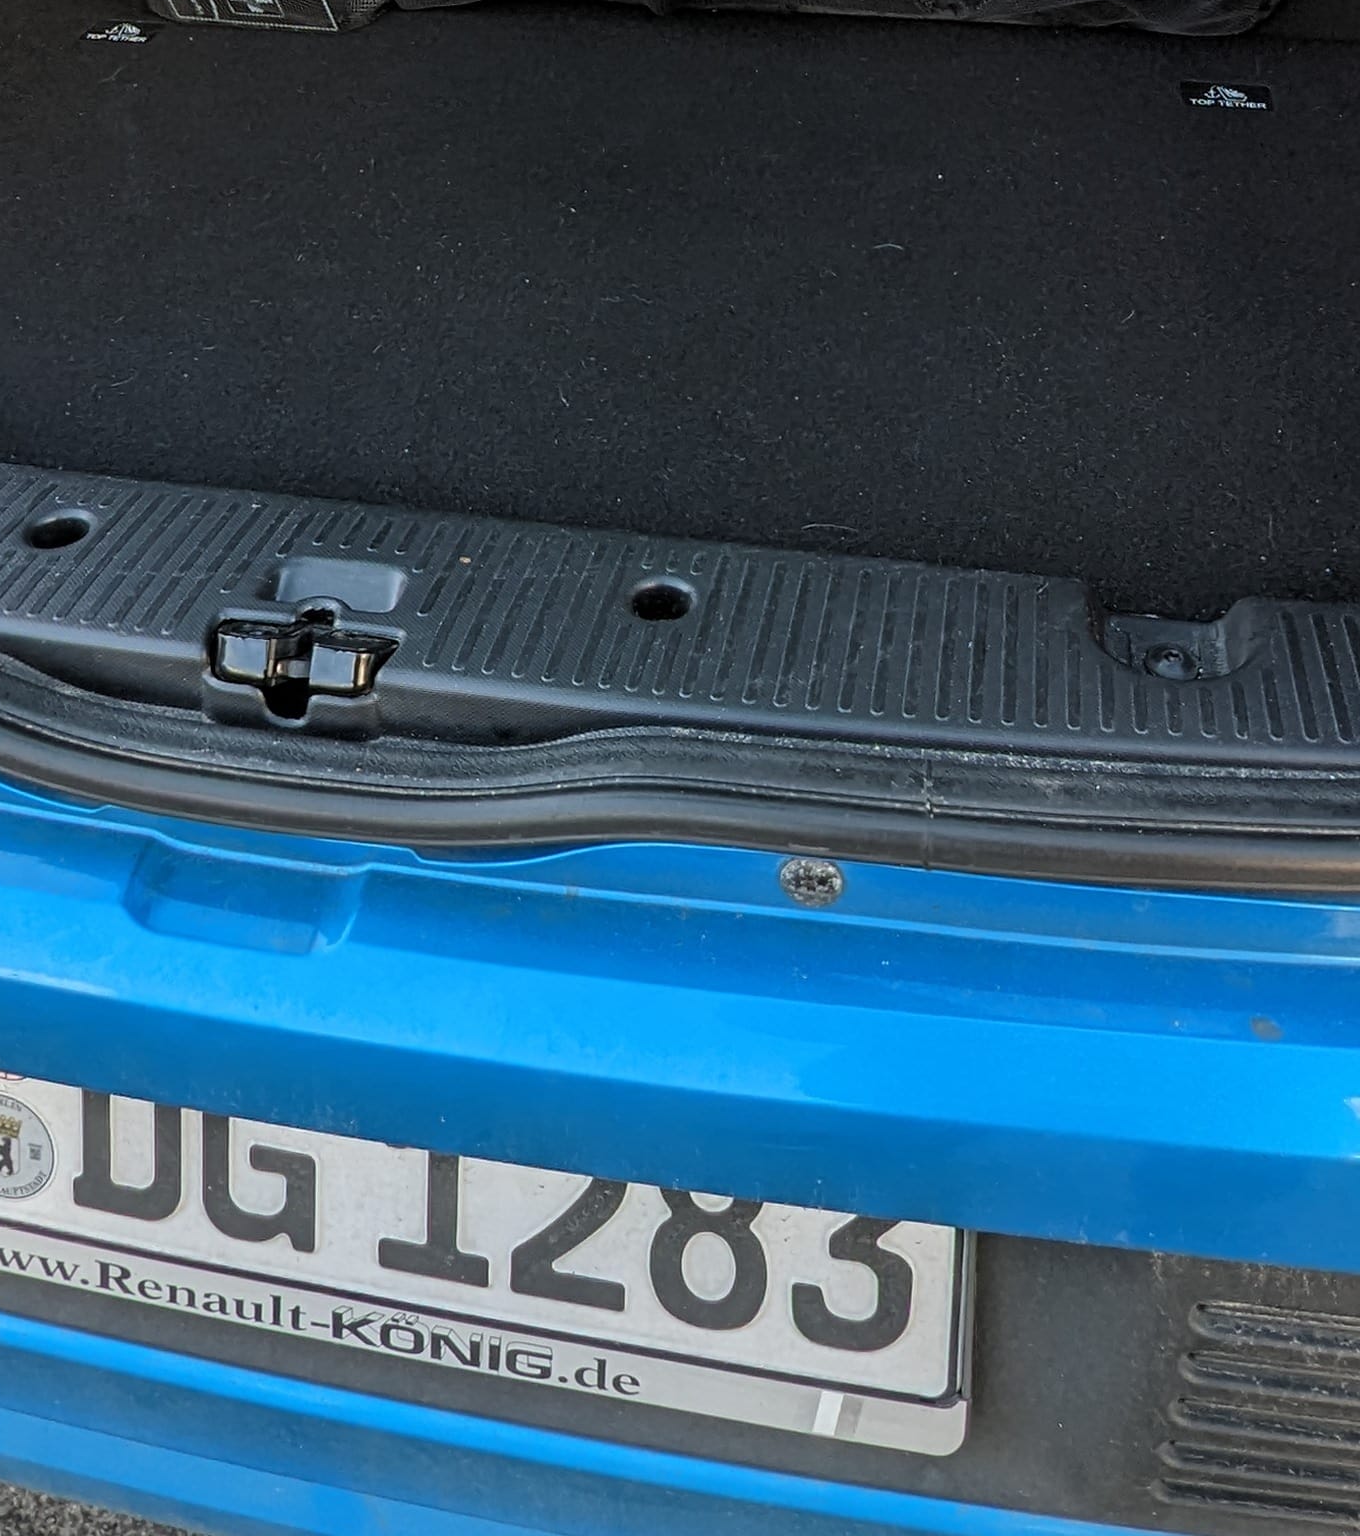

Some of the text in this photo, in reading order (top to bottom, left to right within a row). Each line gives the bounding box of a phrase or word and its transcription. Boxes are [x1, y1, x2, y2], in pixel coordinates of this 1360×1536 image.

[1190, 98, 1267, 109] TOP TETHER
[378, 1150, 914, 1352] 1283
